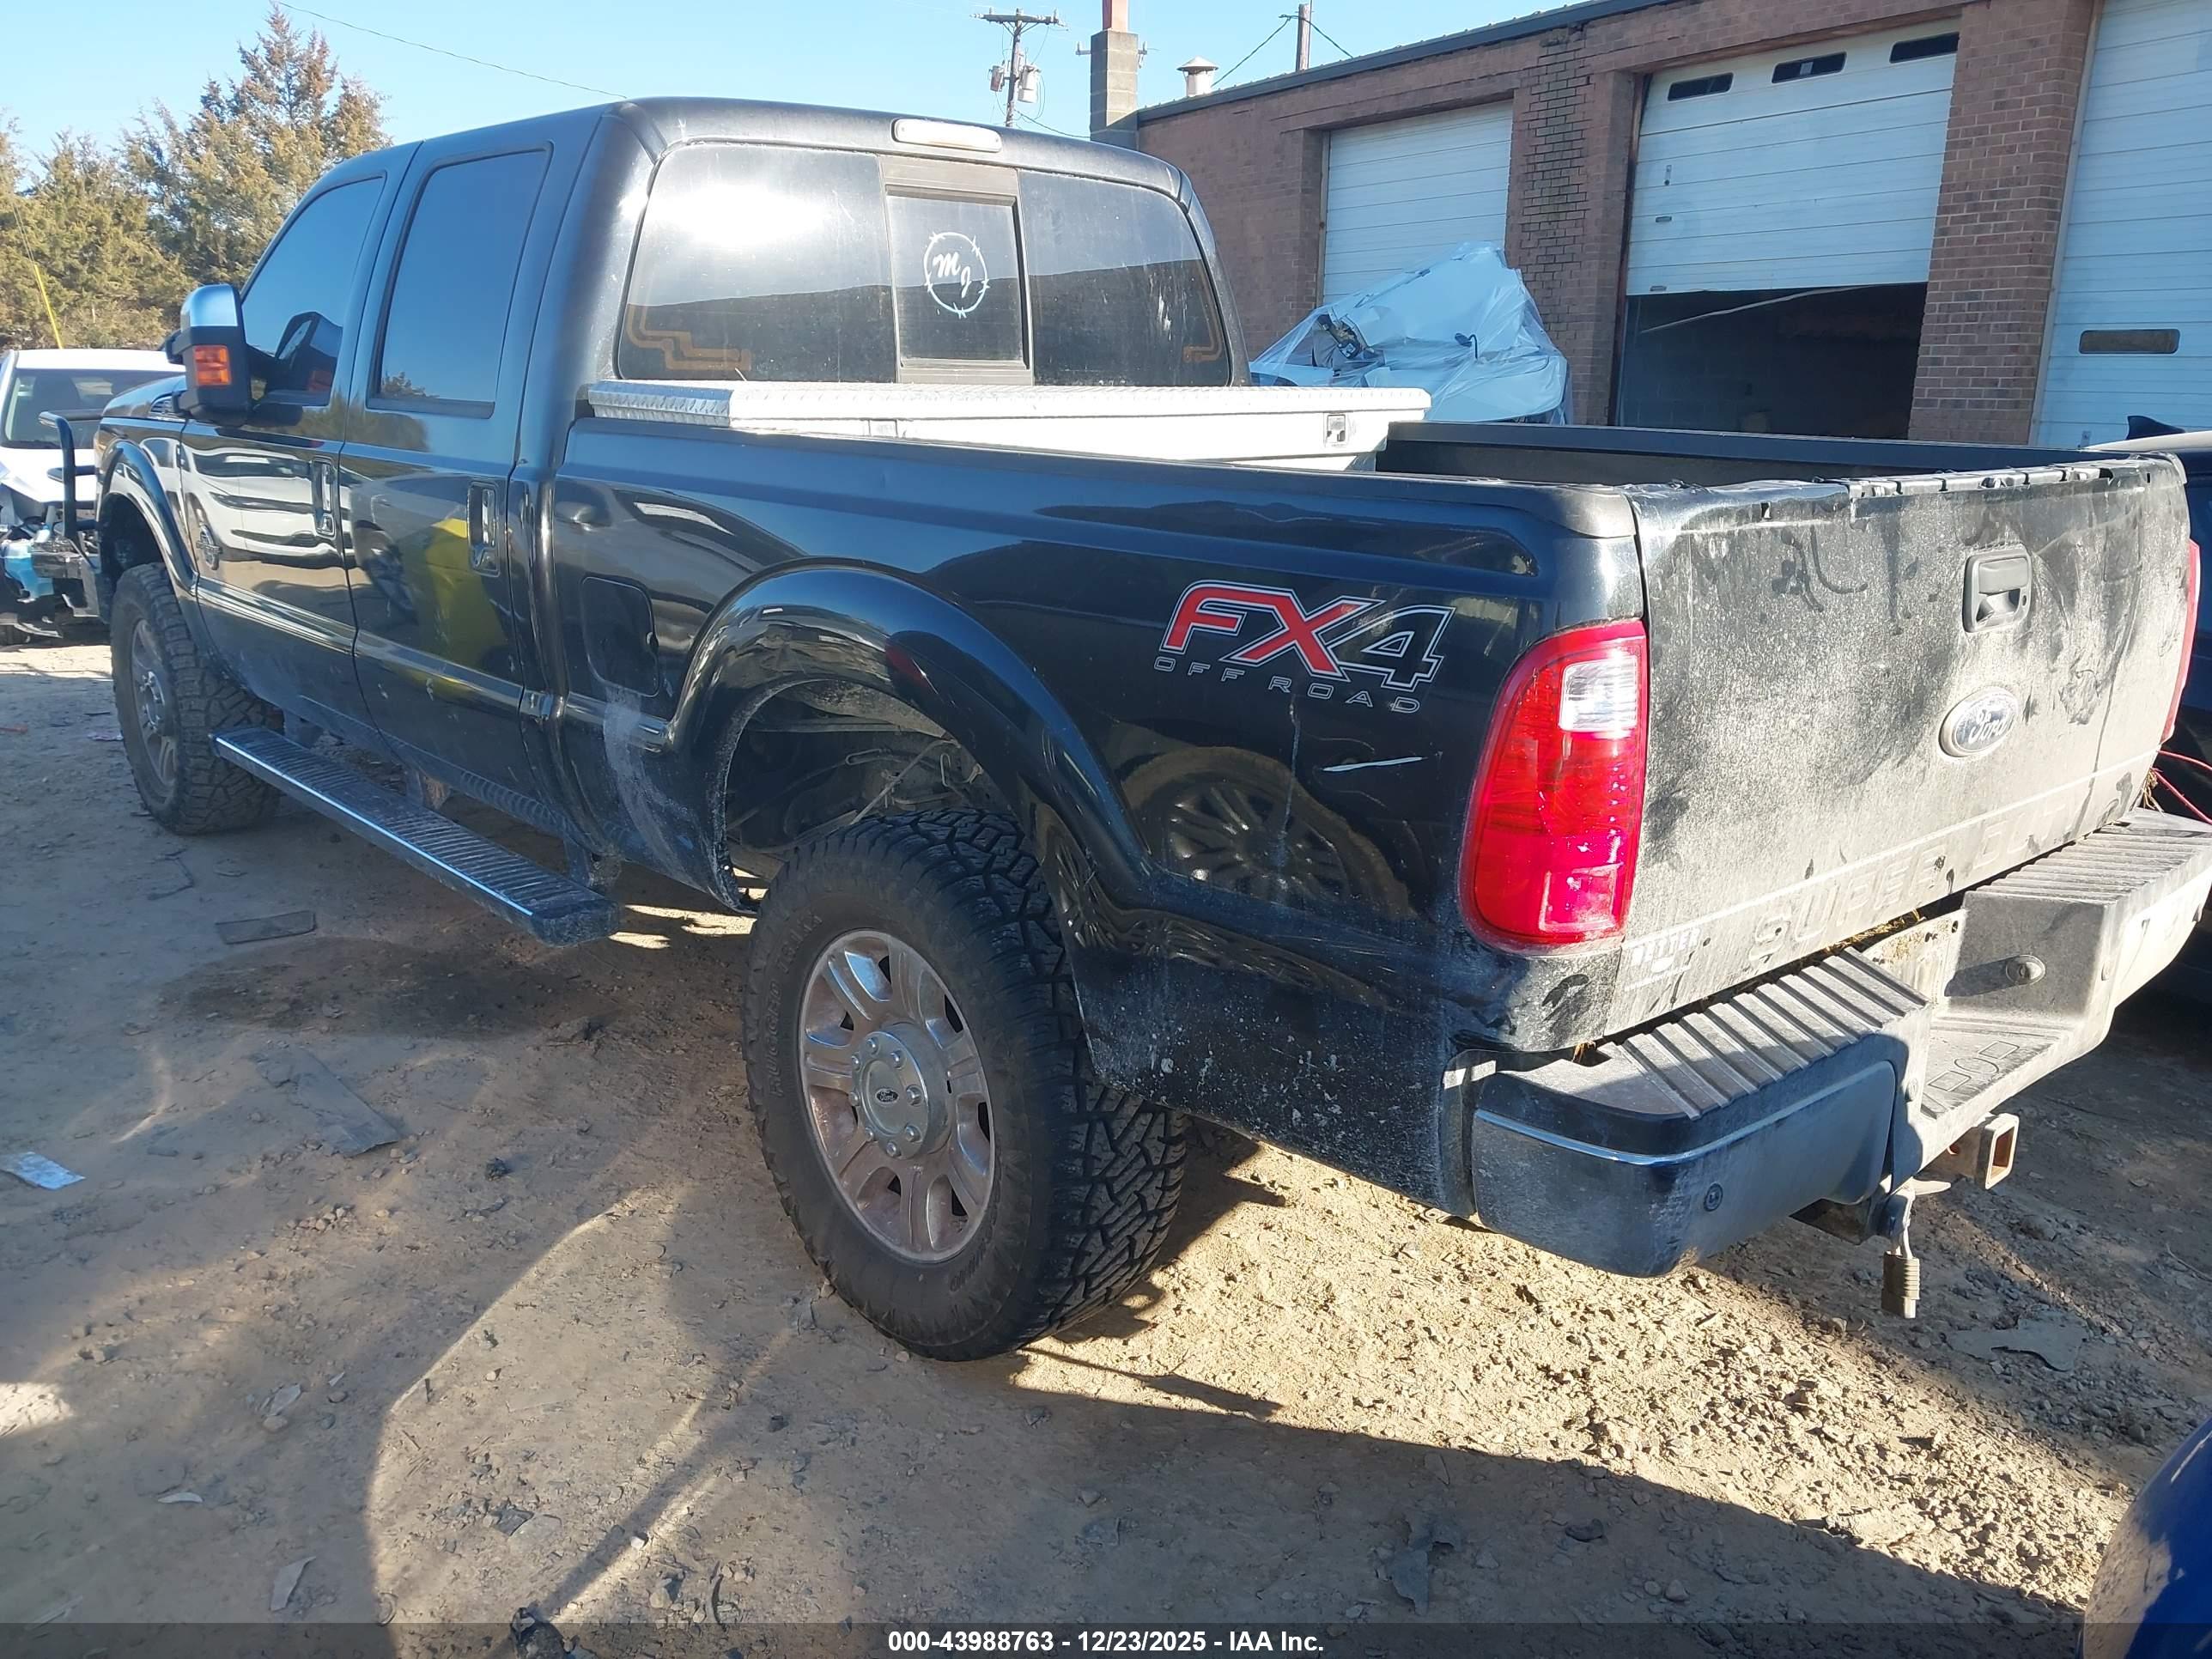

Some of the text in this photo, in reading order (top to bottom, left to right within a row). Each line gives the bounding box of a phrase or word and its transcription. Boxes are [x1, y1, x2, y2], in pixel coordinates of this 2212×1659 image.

[1153, 655, 1422, 714] OFF ROAD
[1159, 580, 1456, 692] FX4
[1748, 845, 1946, 961] SUPER
